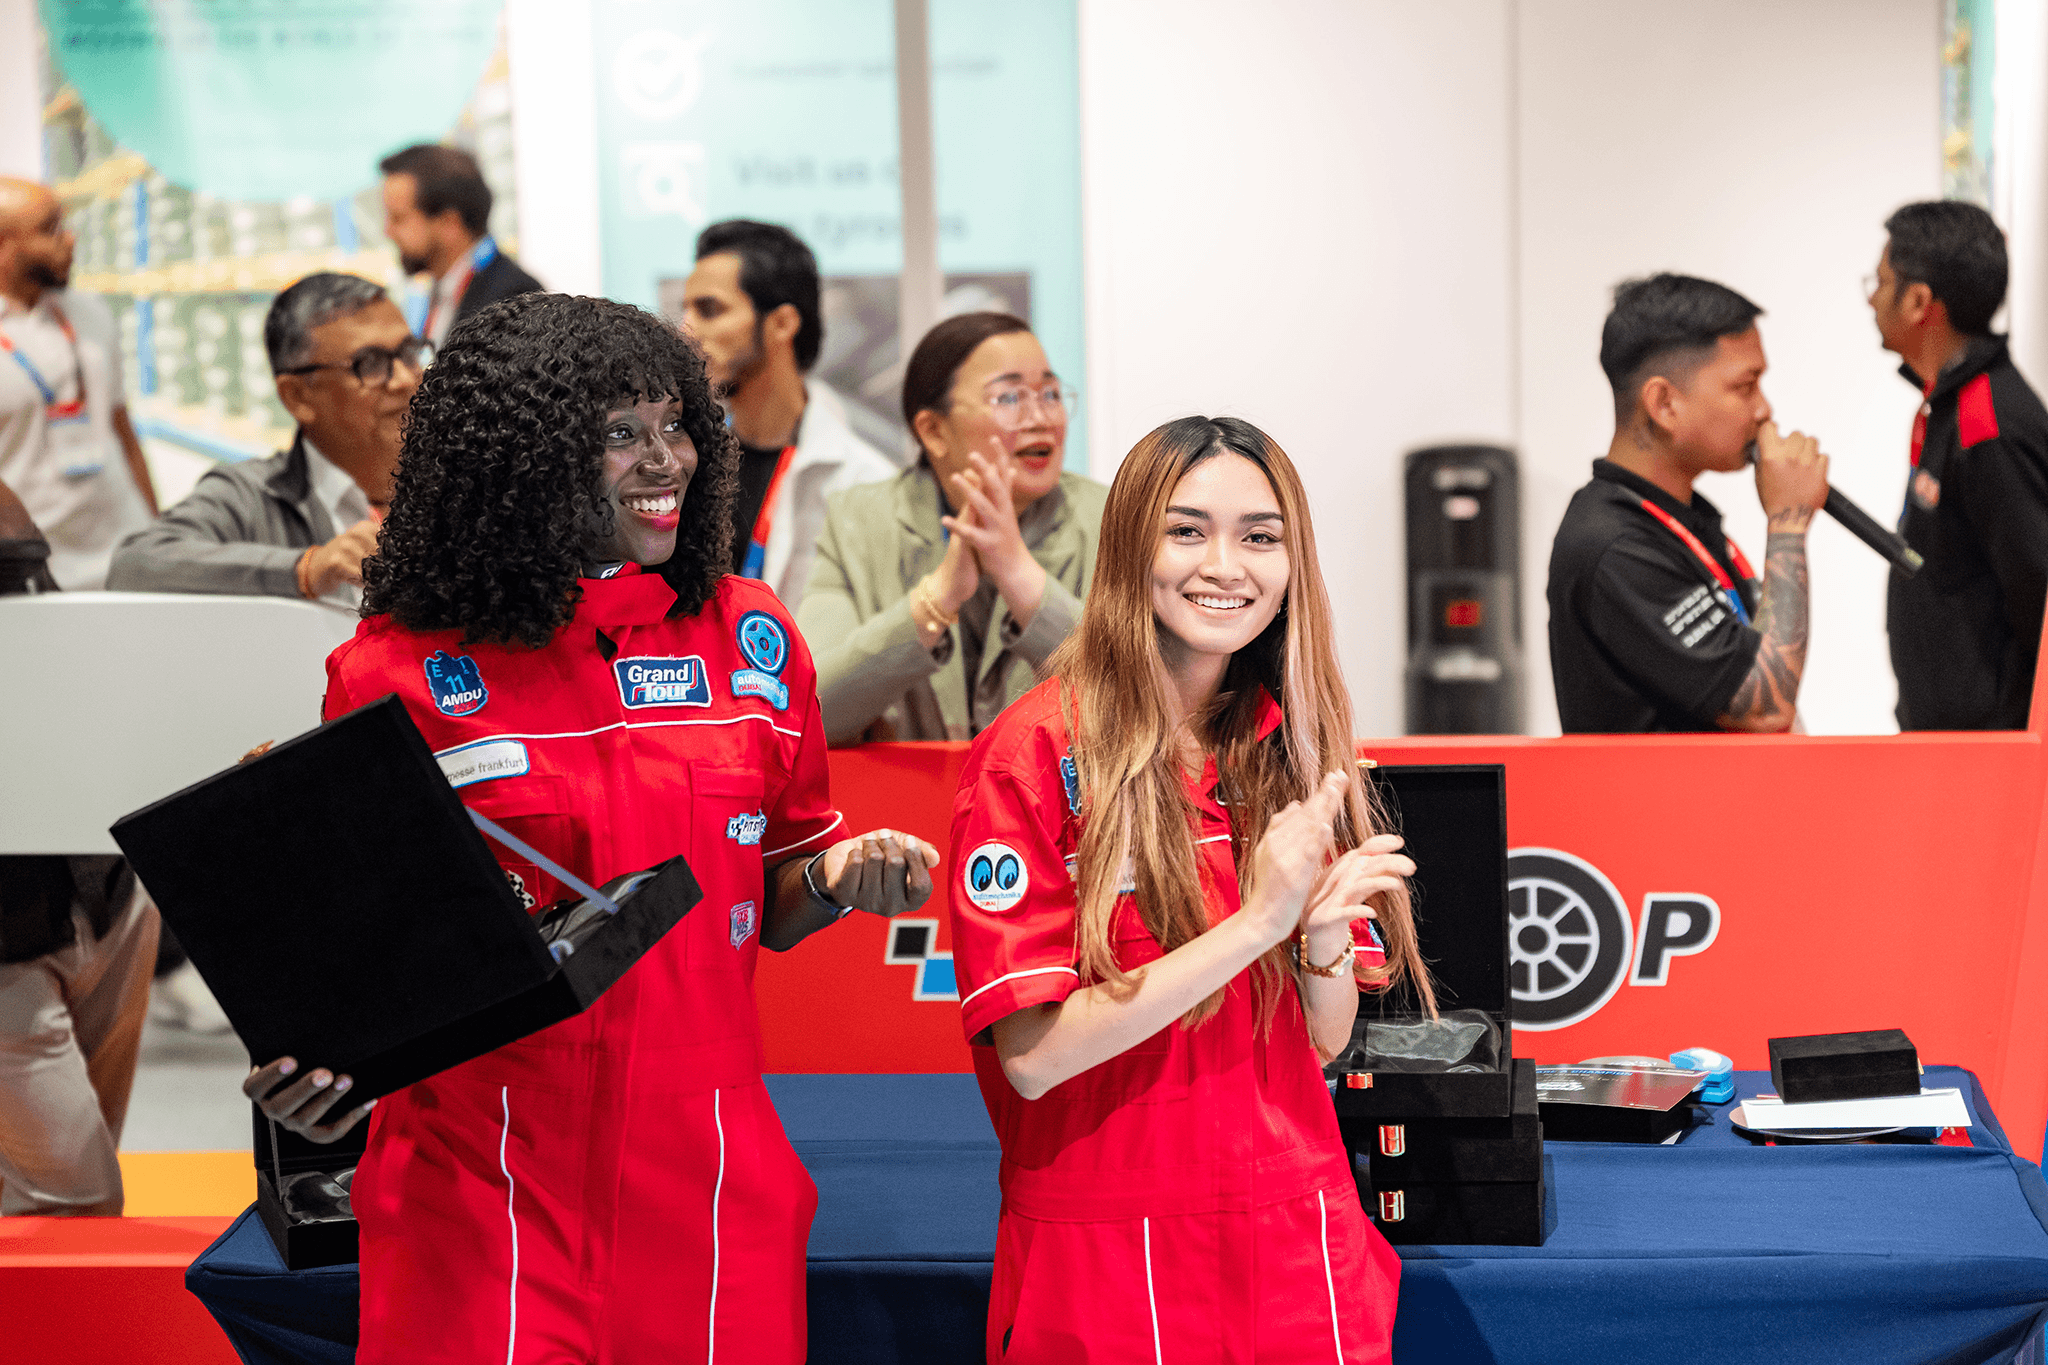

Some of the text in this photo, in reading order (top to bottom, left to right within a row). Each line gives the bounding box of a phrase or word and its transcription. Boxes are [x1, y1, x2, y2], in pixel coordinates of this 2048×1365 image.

[628, 663, 689, 683] Grand
[445, 674, 466, 693] 11
[641, 682, 690, 702] Tour
[441, 688, 482, 707] AMDU
[478, 758, 524, 773] frankfurt
